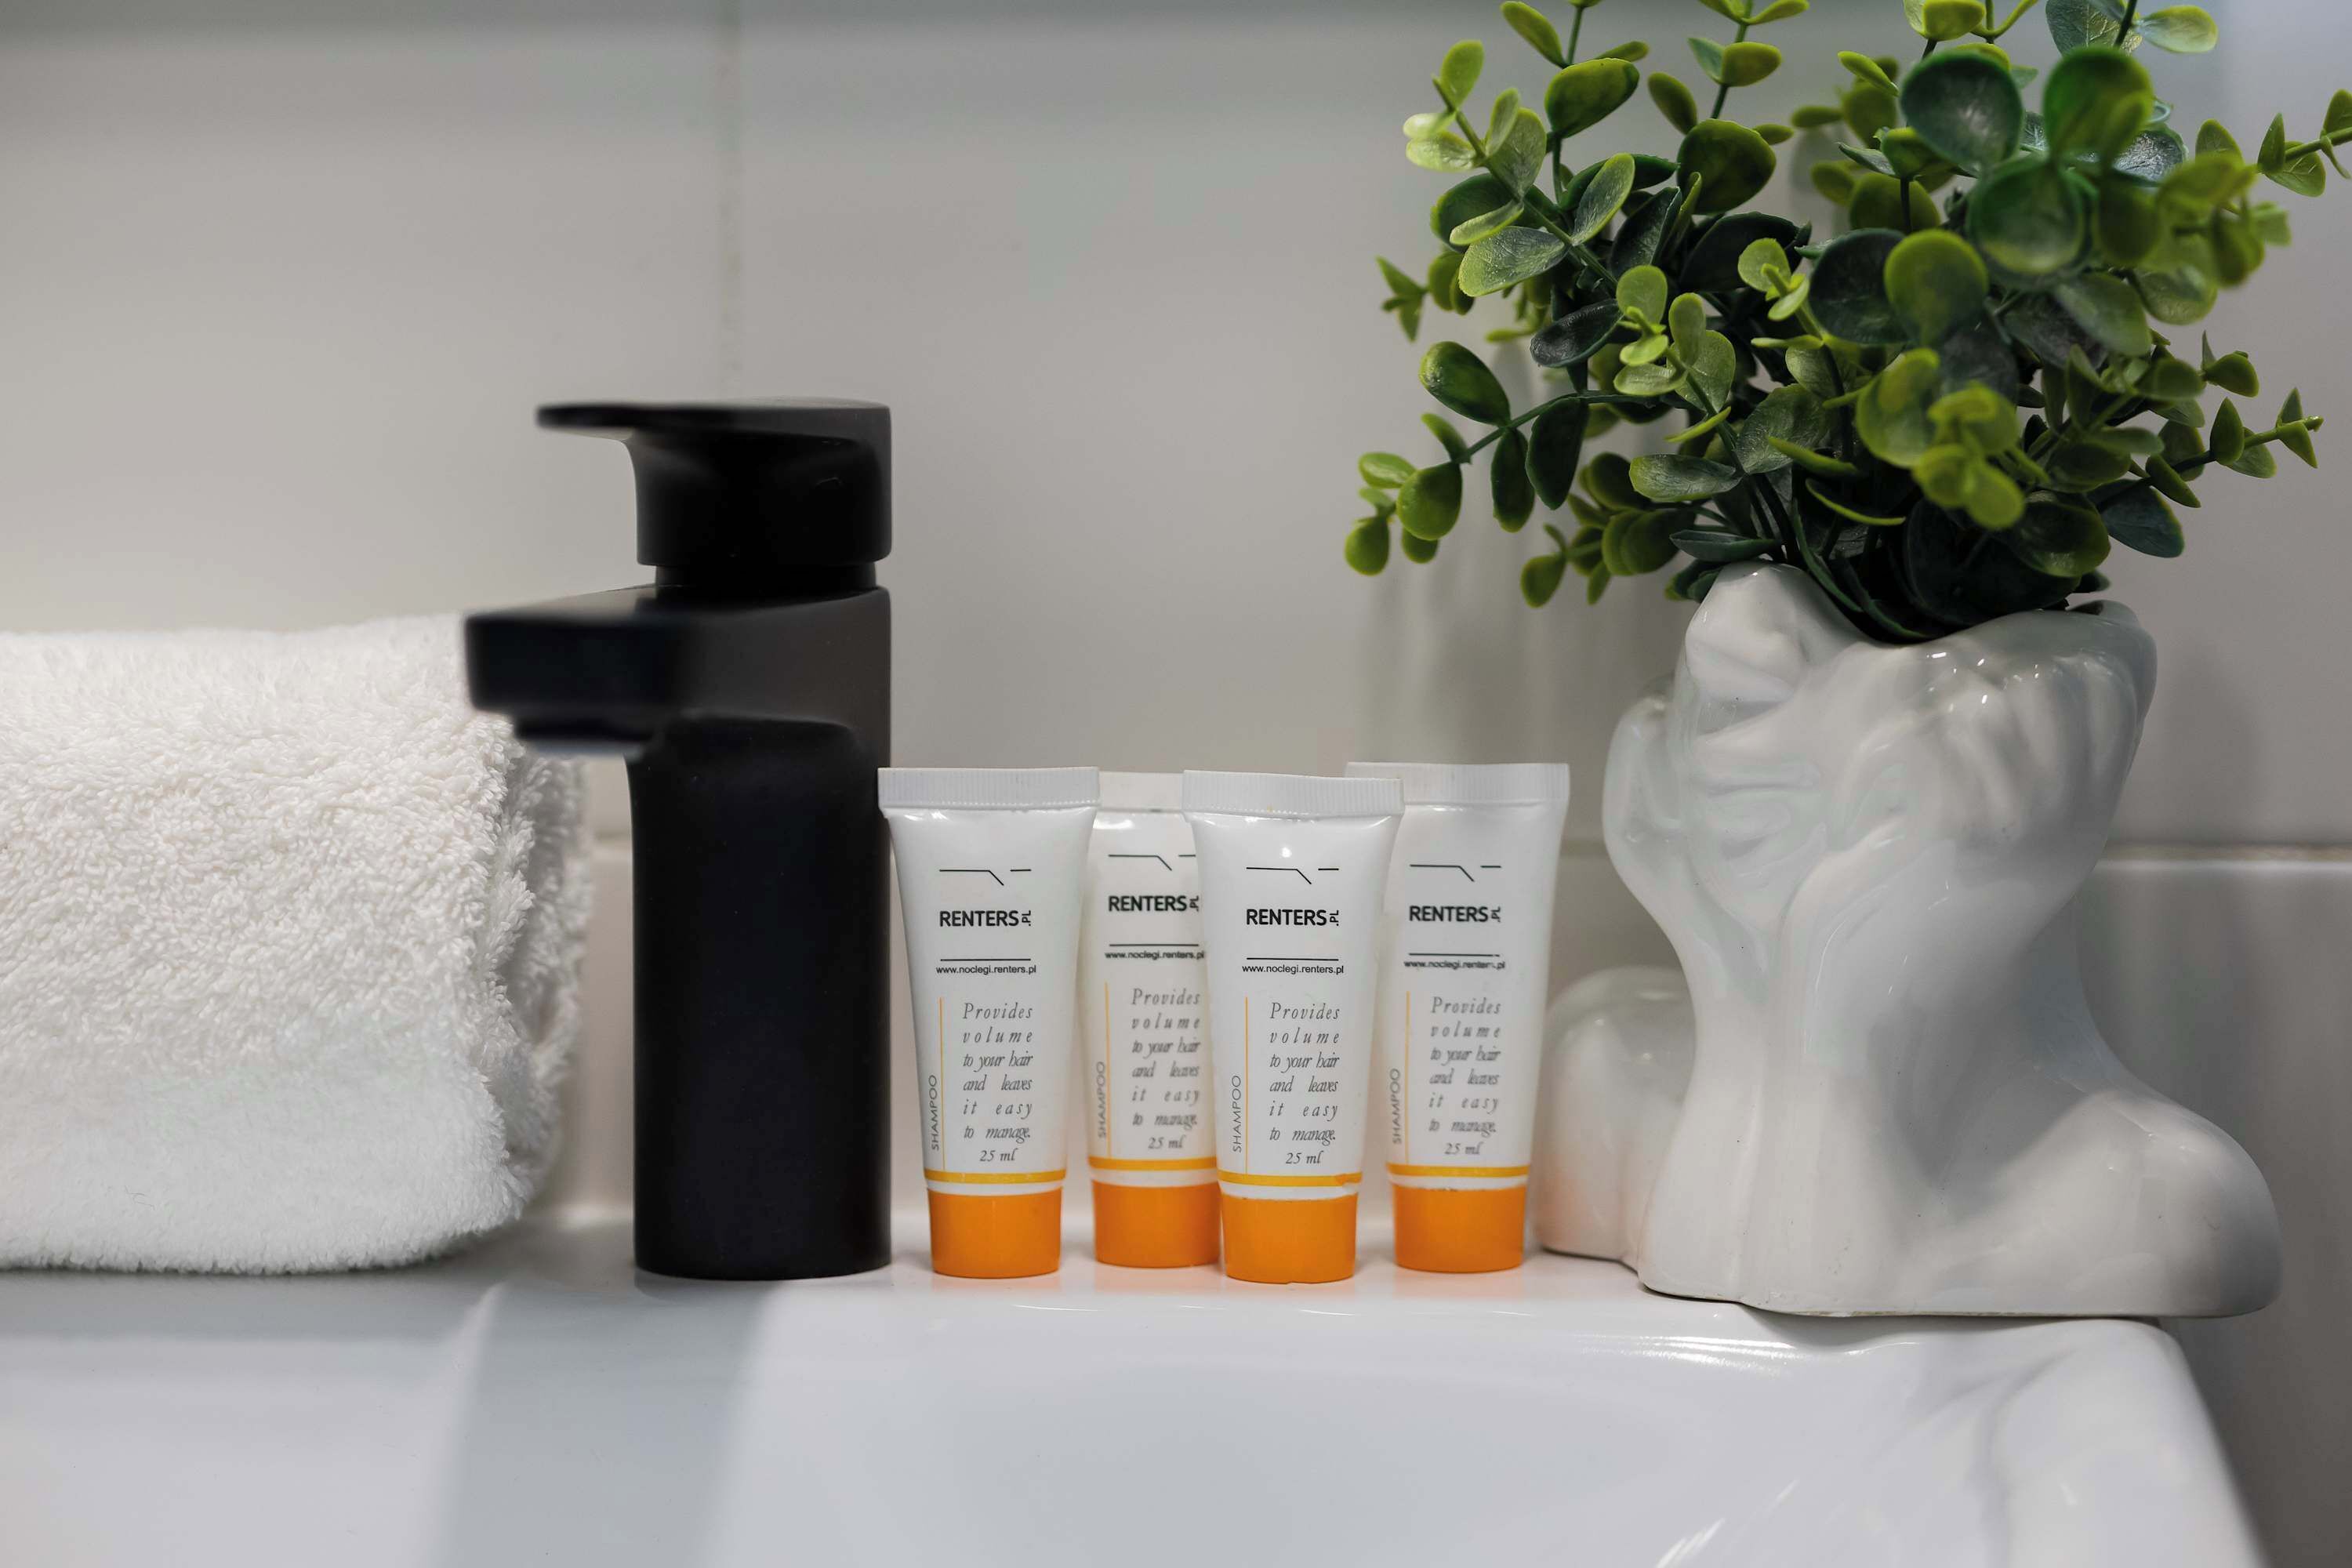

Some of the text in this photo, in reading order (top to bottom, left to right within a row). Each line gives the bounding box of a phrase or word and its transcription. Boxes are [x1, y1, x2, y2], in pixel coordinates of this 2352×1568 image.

[1109, 895, 1187, 911] RENTERS
[940, 910, 1018, 927] RENTERS
[1247, 909, 1327, 926] RENTERS
[1410, 906, 1488, 922] RENTERS
[936, 965, 1036, 975] www.noclegi.renters.pl
[1243, 964, 1344, 975] www.noclegi.renters.pl
[1131, 988, 1200, 1005] Provides
[1432, 996, 1501, 1014] Provides
[963, 1002, 1033, 1019] Provides
[1270, 1003, 1340, 1019] Provides
[1132, 1014, 1200, 1029] volume
[1431, 1021, 1501, 1037] volume
[964, 1026, 1033, 1043] volume
[1270, 1027, 1339, 1044] volume
[1132, 1037, 1201, 1058] to your hair
[1431, 1045, 1501, 1066] to your hair
[963, 1051, 1033, 1073] to your hair
[1132, 1061, 1200, 1077] and leaves
[1270, 1051, 1340, 1073] to your hair
[964, 1074, 1033, 1091] and leaves
[1270, 1076, 1338, 1092] and leaves
[1429, 1068, 1499, 1085] and leaves
[1096, 1062, 1105, 1138] SHAMPOO
[1132, 1087, 1200, 1106] it easy
[1428, 1093, 1499, 1114] it easy
[928, 1075, 938, 1150] SHAMPOO
[964, 1099, 1032, 1120] it easy
[1232, 1076, 1241, 1152] SHAMPOO
[1269, 1101, 1338, 1121] it easy
[1390, 1069, 1401, 1144] SHAMPOO
[1133, 1113, 1143, 1125] to
[1428, 1119, 1439, 1131] to
[964, 1126, 1030, 1144] to manage.
[1148, 1135, 1185, 1149] 25 ml
[1270, 1127, 1335, 1146] to manage.
[980, 1148, 1018, 1161] 25 ml
[1286, 1150, 1323, 1163] 25 ml
[1445, 1142, 1483, 1155] 25 ml
